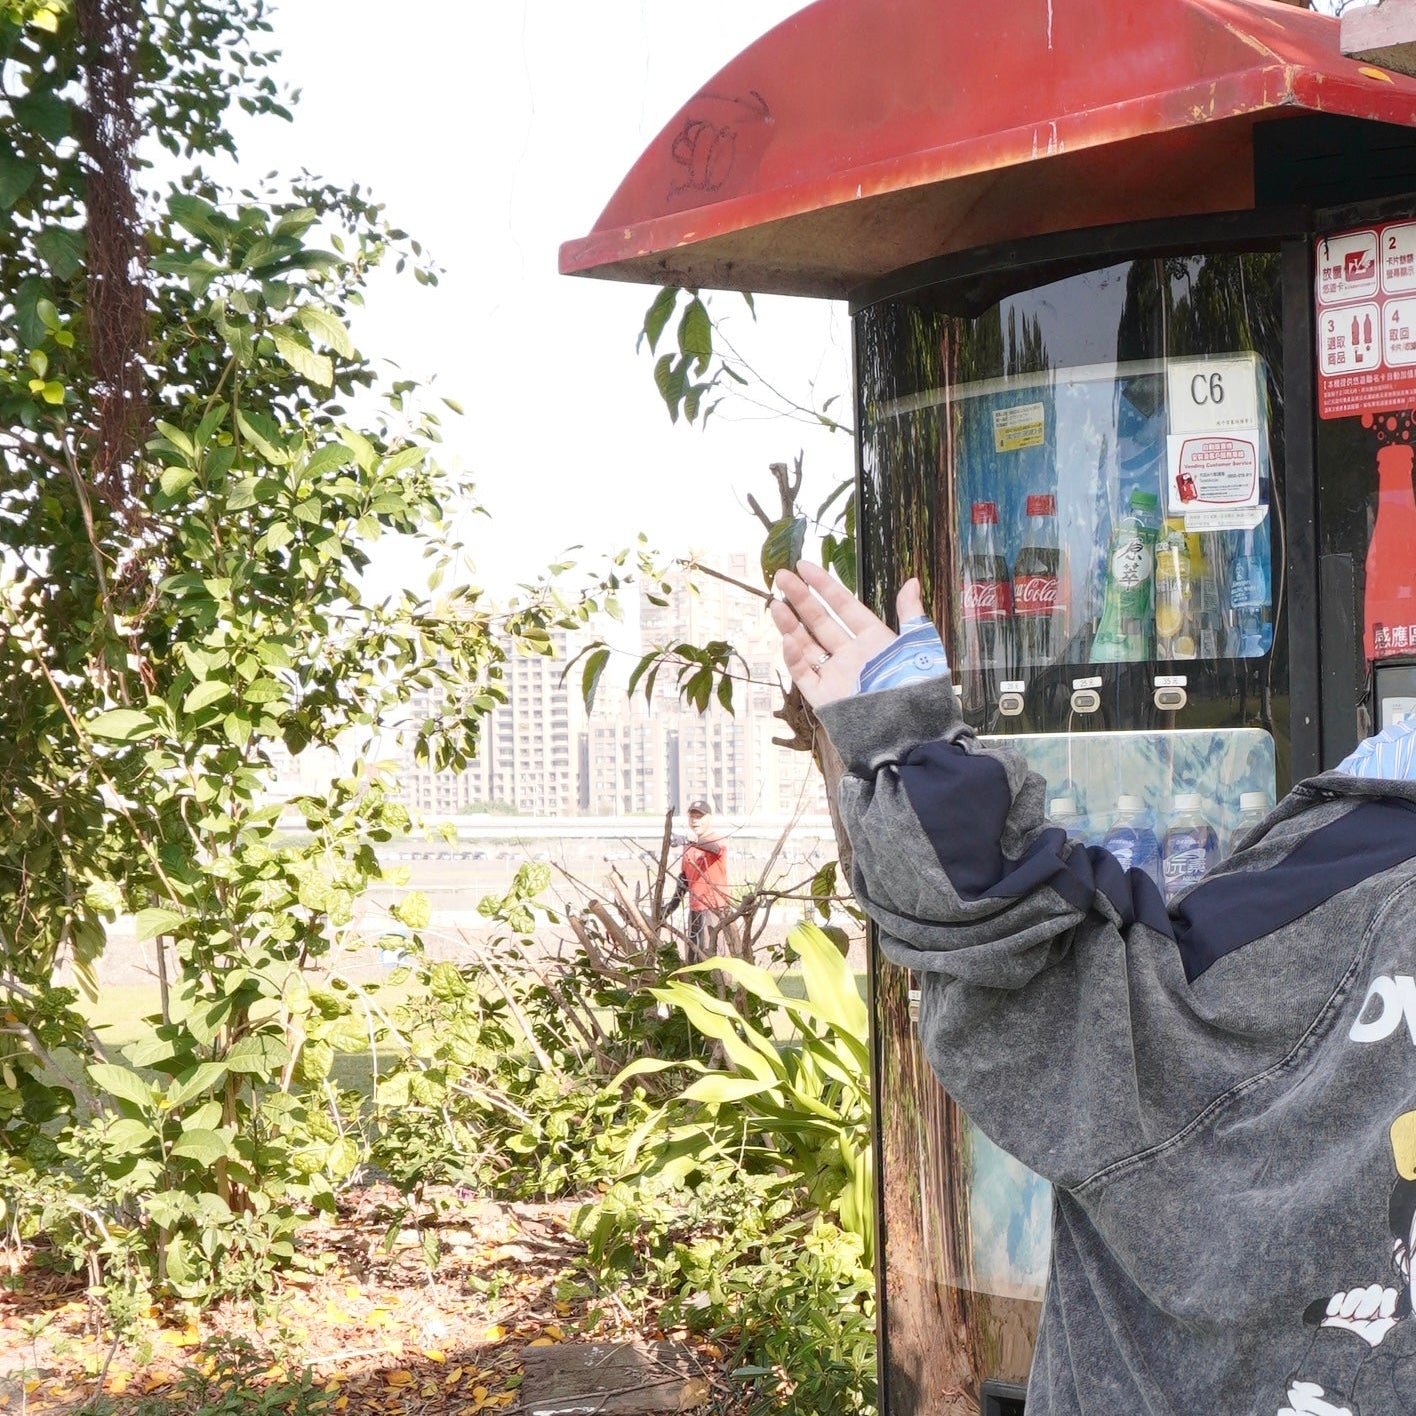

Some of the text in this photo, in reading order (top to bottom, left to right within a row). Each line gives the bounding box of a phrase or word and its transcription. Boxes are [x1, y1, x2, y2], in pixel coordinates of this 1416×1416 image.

[1389, 237, 1397, 250] 2
[1392, 310, 1400, 323] 4
[1327, 320, 1335, 333] 3
[1190, 372, 1225, 406] C6
[1117, 537, 1144, 592] 原萃
